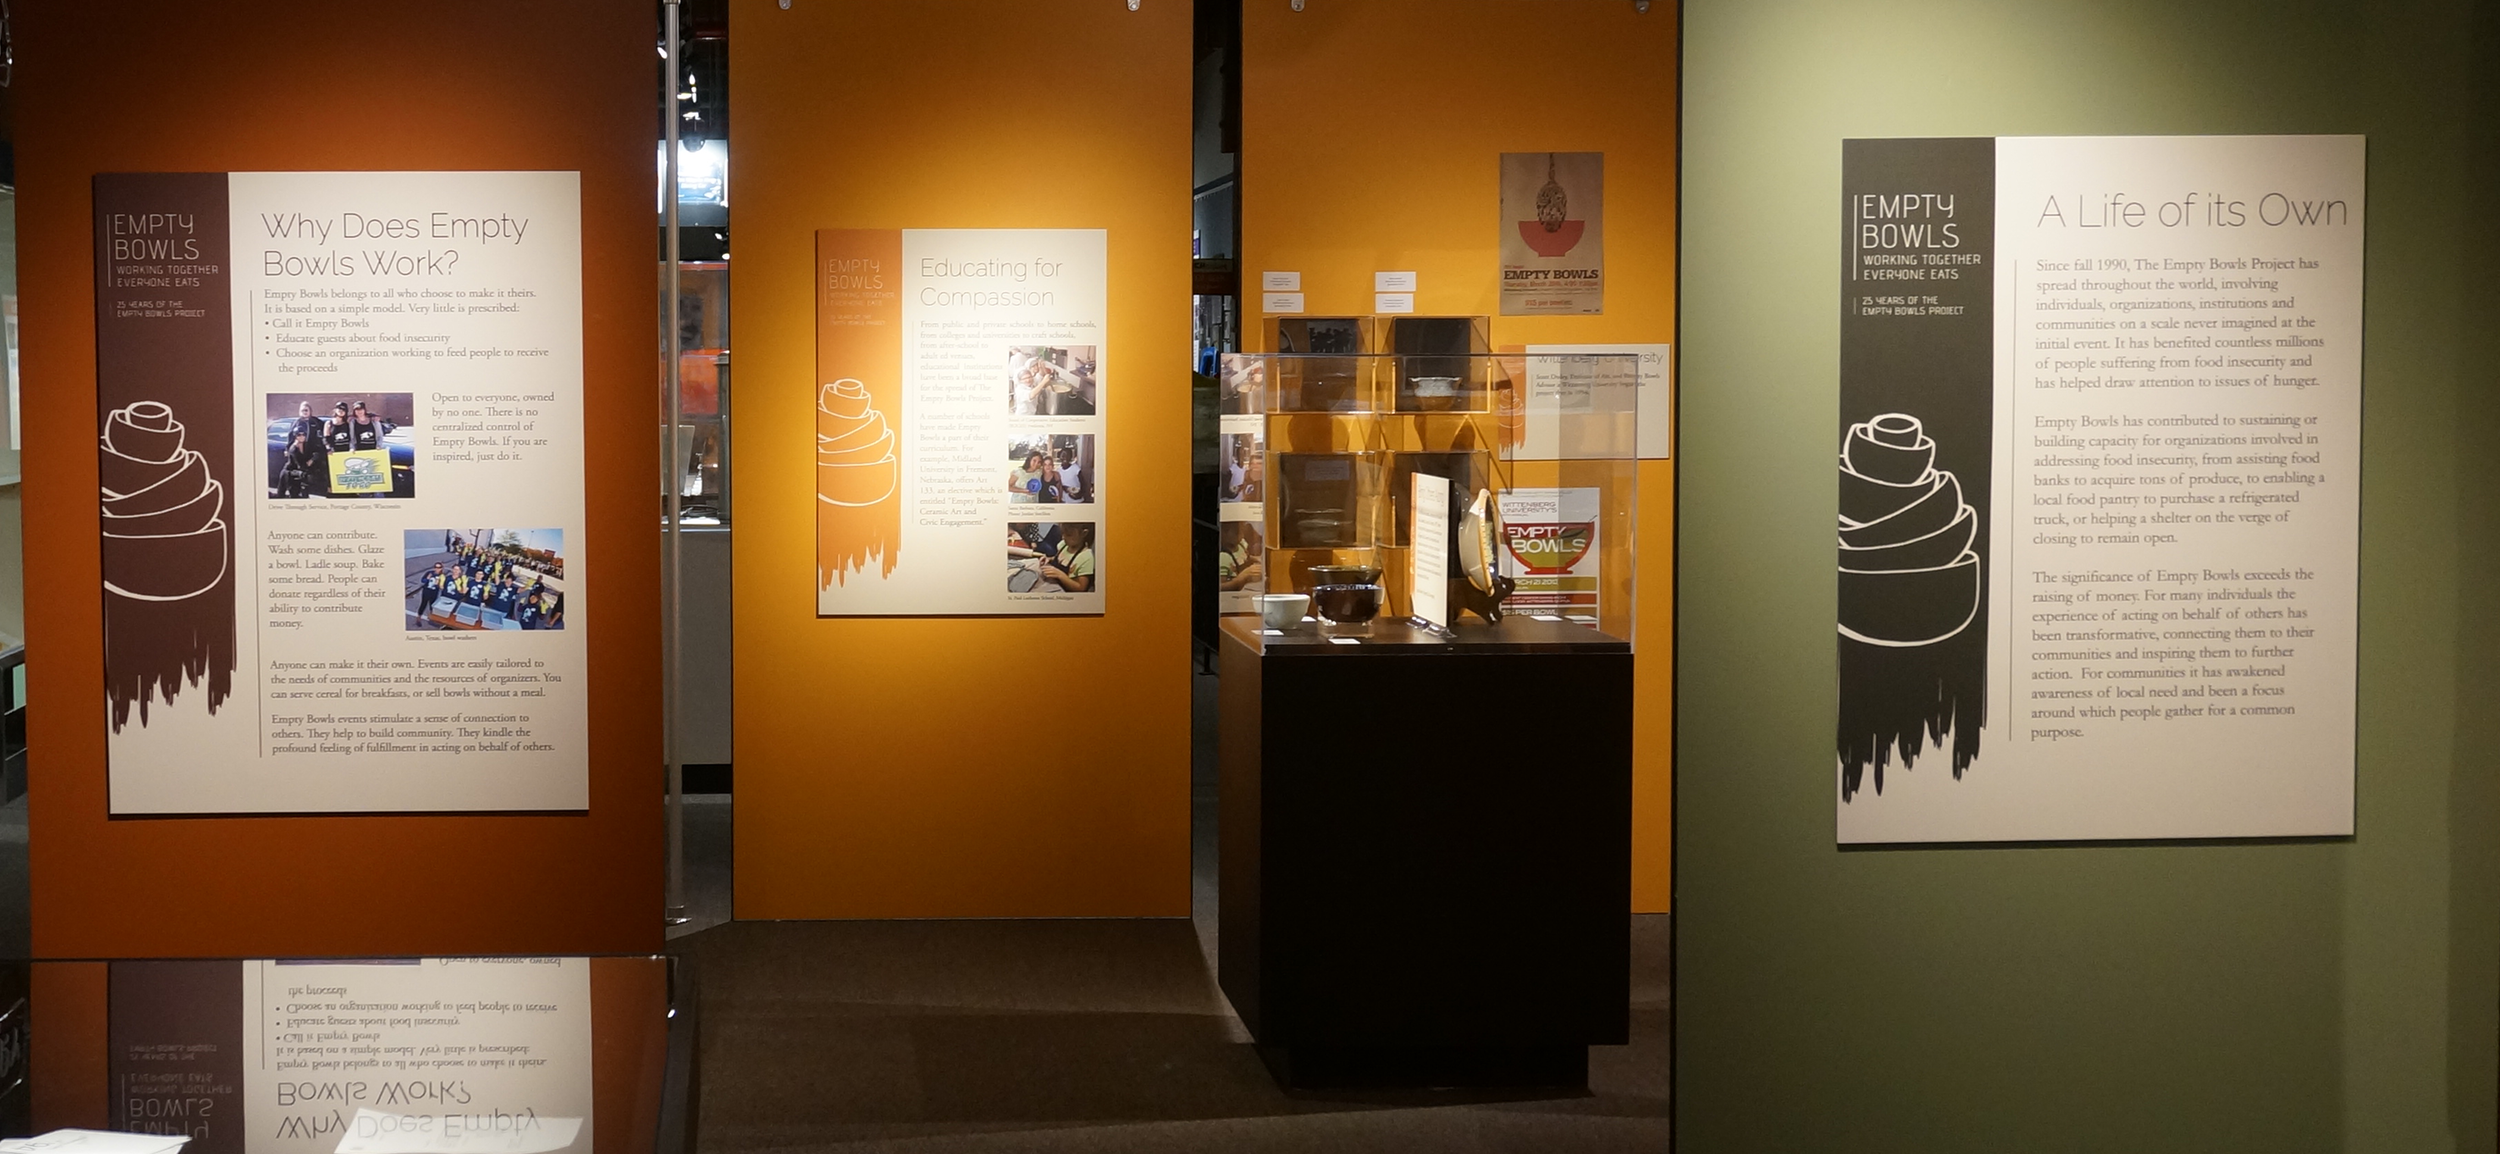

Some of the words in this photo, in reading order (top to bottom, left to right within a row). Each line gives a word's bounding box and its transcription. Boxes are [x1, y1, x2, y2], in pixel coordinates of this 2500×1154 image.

[1863, 194, 1954, 219] EMPTY
[2037, 195, 2066, 227] A
[2079, 193, 2146, 228] Life
[2158, 192, 2198, 227] of
[2208, 192, 2246, 227] its
[2259, 192, 2347, 226] Own
[114, 214, 194, 235] EMPTY
[261, 213, 333, 246] Why
[343, 213, 420, 239] Does
[431, 212, 529, 245] Empty
[1863, 223, 1960, 248] BOWLS
[115, 239, 200, 260] BOWLS
[264, 250, 355, 276] Bowls
[362, 250, 459, 276] Work?
[829, 258, 880, 273] EMPTY
[1863, 255, 1918, 265] WORKING
[1922, 254, 1981, 265] TOGETHER
[2037, 260, 2070, 271] Since
[2074, 259, 2093, 271] fall
[2098, 259, 2131, 272] 1990,
[2134, 259, 2160, 270] The
[2163, 258, 2206, 274] Empty
[2209, 258, 2248, 270] Bowls
[2251, 258, 2296, 272] Project
[2298, 257, 2320, 269] has
[116, 266, 164, 275] WORKING
[167, 265, 219, 275] TOGETHER
[920, 257, 1027, 282] Educating
[1034, 257, 1064, 277] for
[1504, 269, 1551, 280] EMPTY
[1553, 269, 1599, 280] BOWLS
[1864, 269, 1926, 280] EVERYONE
[1930, 269, 1959, 280] EATS
[117, 278, 171, 287] EVERYONE
[175, 278, 200, 287] EATS
[829, 275, 884, 290] BOWLS
[2037, 279, 2077, 295] spread
[2081, 278, 2152, 294] throughout
[2155, 278, 2175, 290] the
[2178, 277, 2218, 291] world,
[2221, 277, 2279, 293] involving
[264, 289, 297, 301] Empty
[300, 288, 329, 298] Bowls
[331, 288, 368, 301] belongs
[383, 288, 394, 298] all
[397, 288, 418, 298] who
[420, 288, 453, 298] choose
[469, 288, 495, 298] make
[497, 289, 505, 298] it
[507, 288, 537, 297] theirs.
[919, 287, 1054, 310] Compassion
[1862, 297, 1874, 305] 25
[1875, 296, 1905, 305] YEARS
[1907, 296, 1919, 305] OF
[1922, 296, 1939, 305] THE
[1862, 307, 1893, 315] EMPTY
[1894, 306, 1926, 315] BOWLS
[1928, 306, 1964, 315] PROJECT
[2036, 298, 2106, 312] individuals,
[2109, 298, 2196, 313] organizations,
[2199, 297, 2269, 309] institutions
[2272, 296, 2295, 309] and
[272, 318, 293, 328] Call
[295, 319, 302, 328] it
[305, 318, 338, 331] Empty
[341, 318, 370, 328] Bowls
[276, 333, 315, 343] Educate
[317, 336, 347, 346] guests
[349, 333, 376, 343] about
[379, 332, 401, 342] food
[404, 334, 451, 345] insecurity
[431, 393, 460, 405] Open
[474, 395, 520, 404] everyone,
[522, 391, 555, 402] owned
[267, 531, 305, 542] Anyone
[326, 530, 378, 539] contribute.
[1507, 527, 1566, 538] EMPTY
[2033, 532, 2078, 548] closing
[2081, 535, 2094, 544] to
[2097, 532, 2140, 544] remain
[2144, 535, 2178, 547] open.
[1512, 539, 1587, 553] BOWLS
[2032, 571, 2058, 583] The
[2062, 570, 2134, 586] significance
[2137, 570, 2153, 582] of
[2157, 570, 2199, 585] Empty
[2203, 569, 2240, 581] Bowls
[2244, 568, 2291, 580] exceeds
[2295, 568, 2315, 580] the
[2031, 729, 2085, 742] purpose.
[272, 743, 317, 756] profound
[320, 743, 352, 755] feeling
[353, 742, 366, 752] of
[366, 742, 417, 752] fulfillment
[419, 743, 429, 752] in
[431, 743, 462, 755] acting
[478, 741, 510, 752] behalf
[510, 741, 522, 751] of
[522, 741, 555, 751] others.
